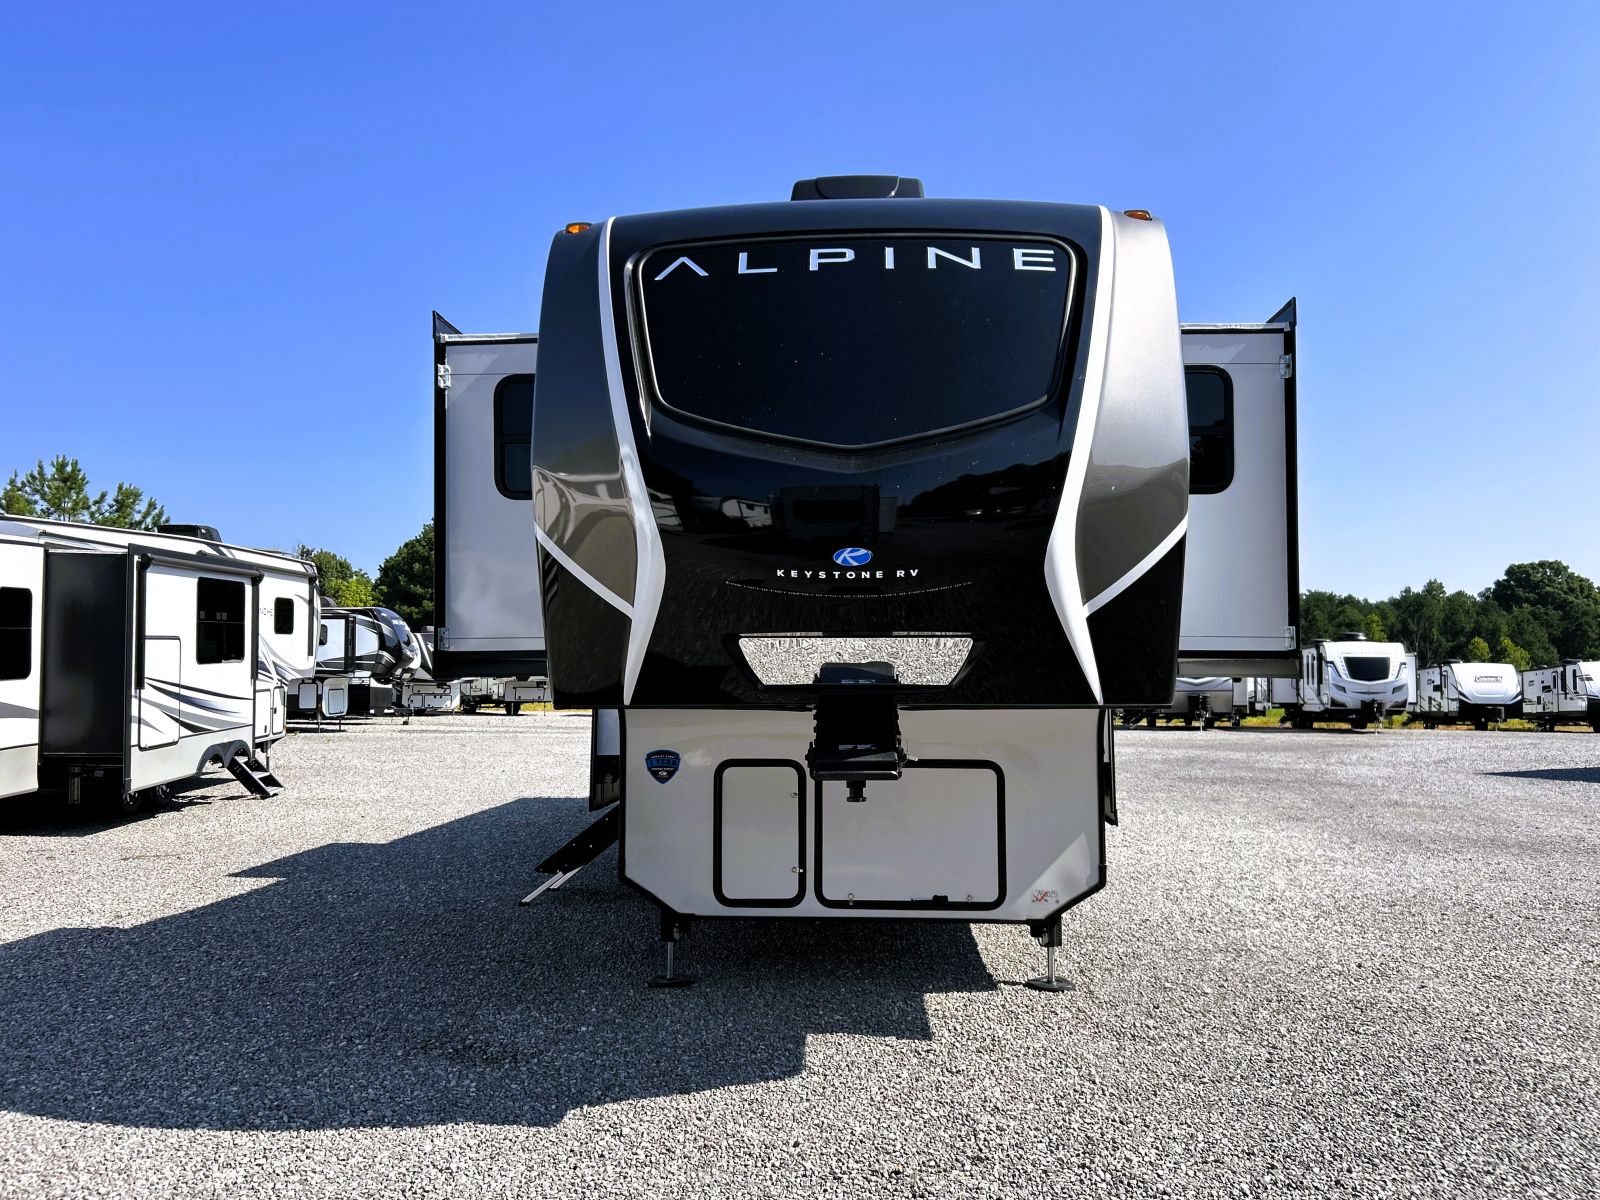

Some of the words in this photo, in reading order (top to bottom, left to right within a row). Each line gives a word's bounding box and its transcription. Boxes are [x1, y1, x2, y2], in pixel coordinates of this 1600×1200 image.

[654, 245, 1057, 281] ALPINE
[776, 569, 884, 579] KEYSTONE
[896, 568, 920, 578] RV
